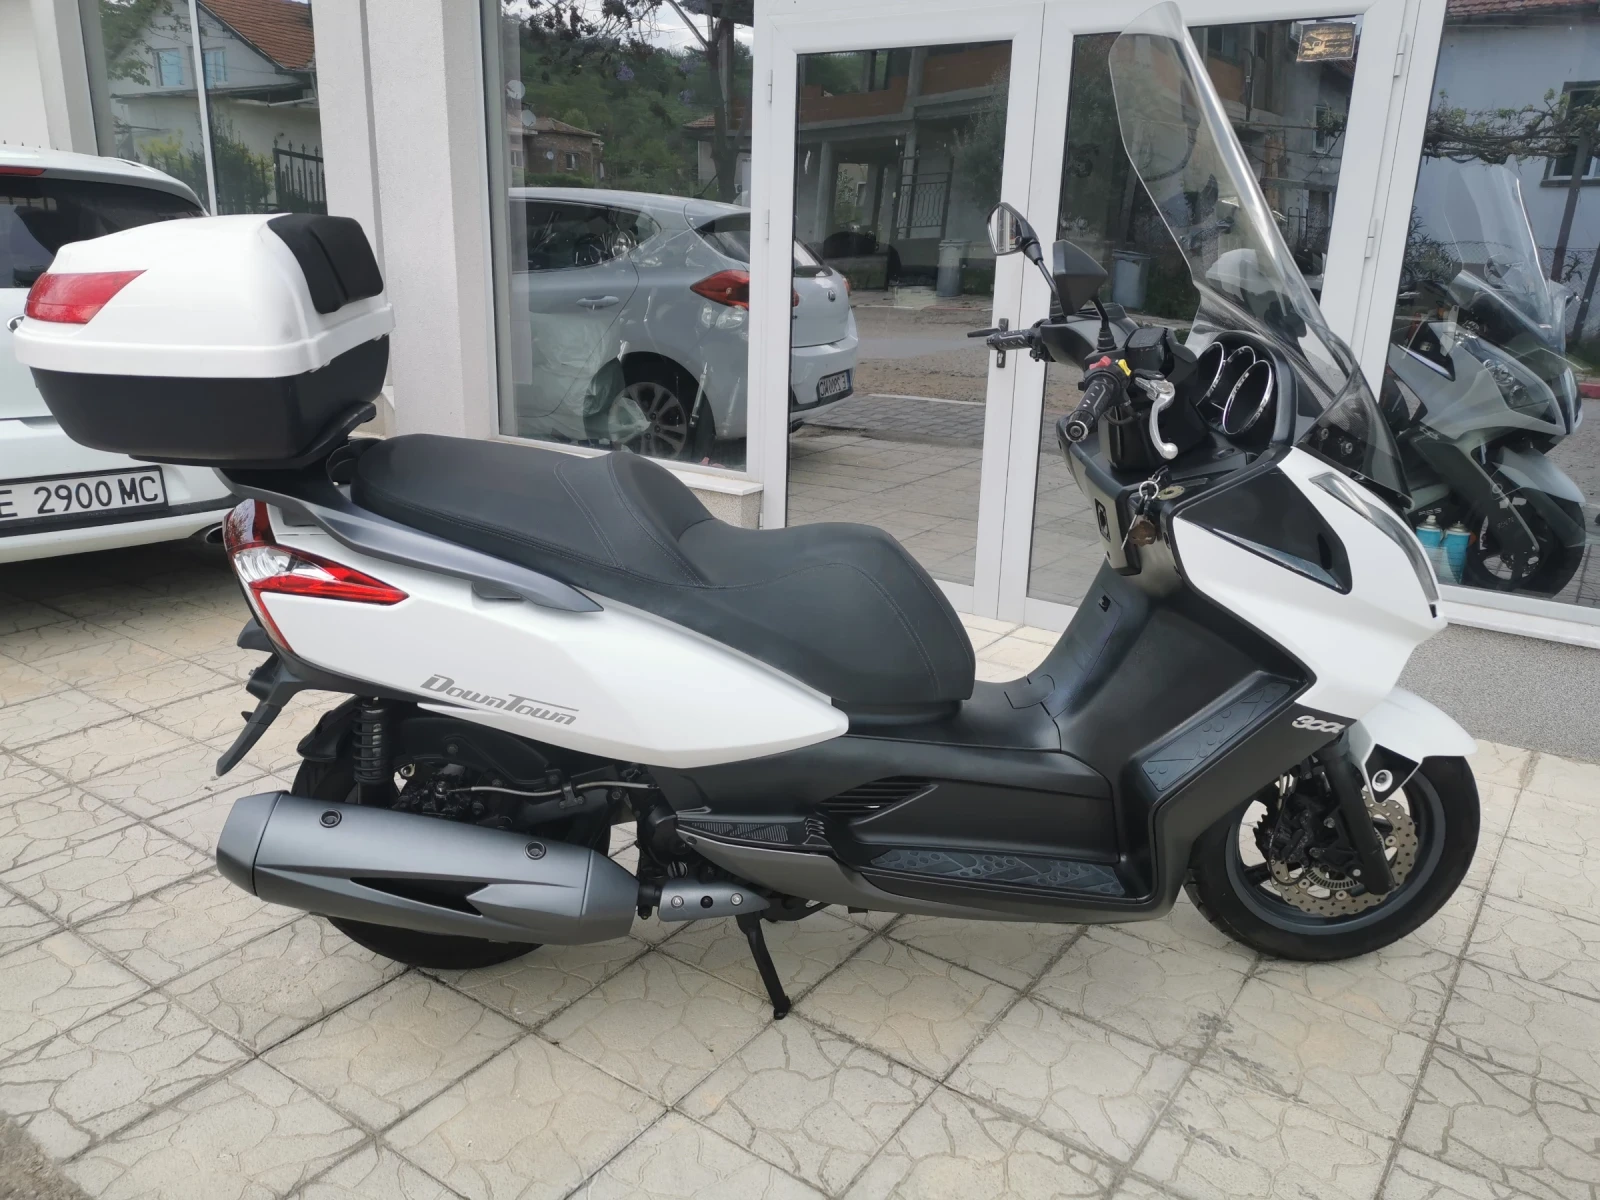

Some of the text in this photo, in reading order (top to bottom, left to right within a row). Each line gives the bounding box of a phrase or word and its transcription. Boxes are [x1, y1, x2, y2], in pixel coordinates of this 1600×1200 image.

[0, 476, 158, 517] E 2900 MC
[420, 674, 579, 725] DownTown
